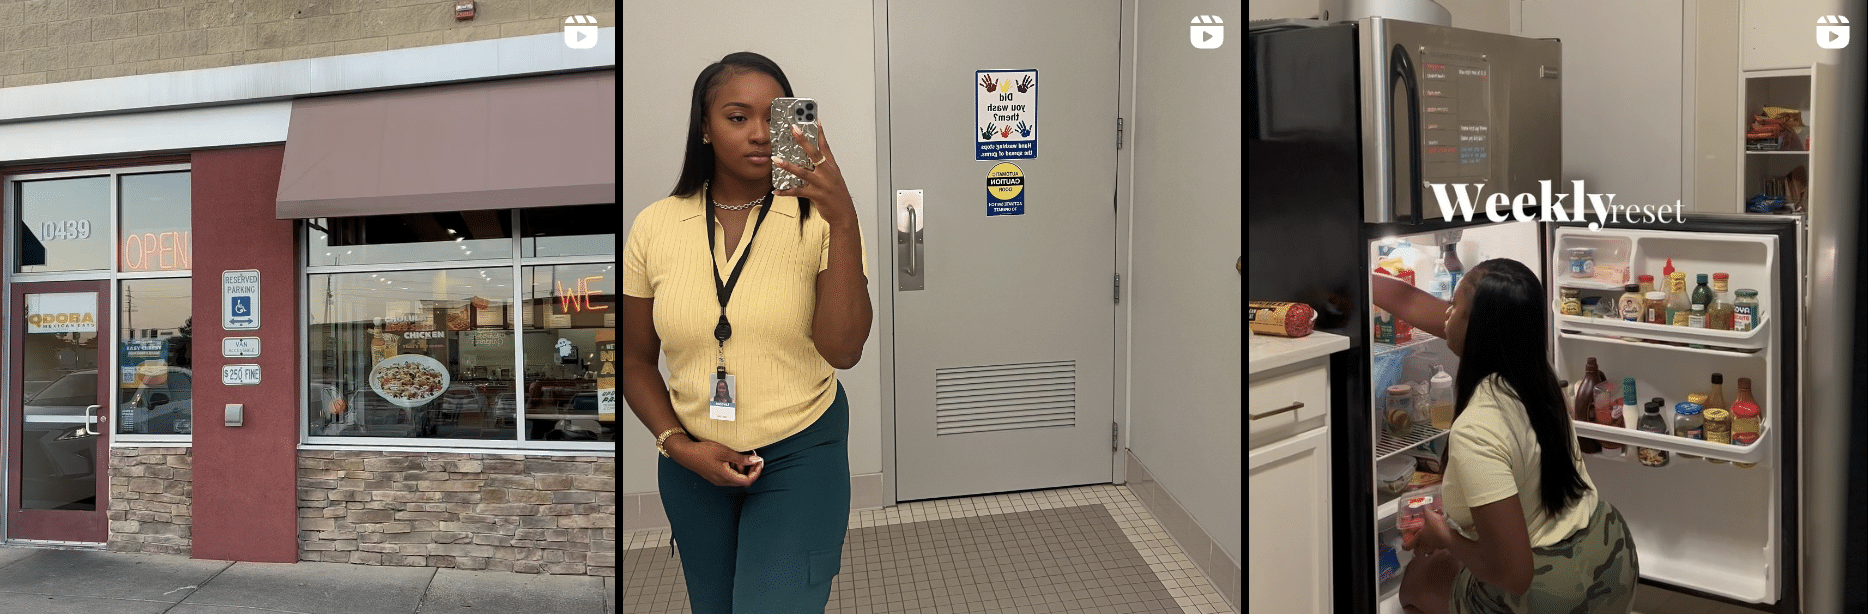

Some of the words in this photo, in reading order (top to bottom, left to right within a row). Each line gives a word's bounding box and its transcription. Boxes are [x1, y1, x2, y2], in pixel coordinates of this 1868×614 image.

[126, 231, 188, 270] OPEN
[225, 275, 257, 284] RESERVED
[557, 276, 608, 312] WE
[29, 312, 94, 328] QDOBA
[404, 331, 445, 339] CHICKEN
[245, 369, 259, 380] FINE
